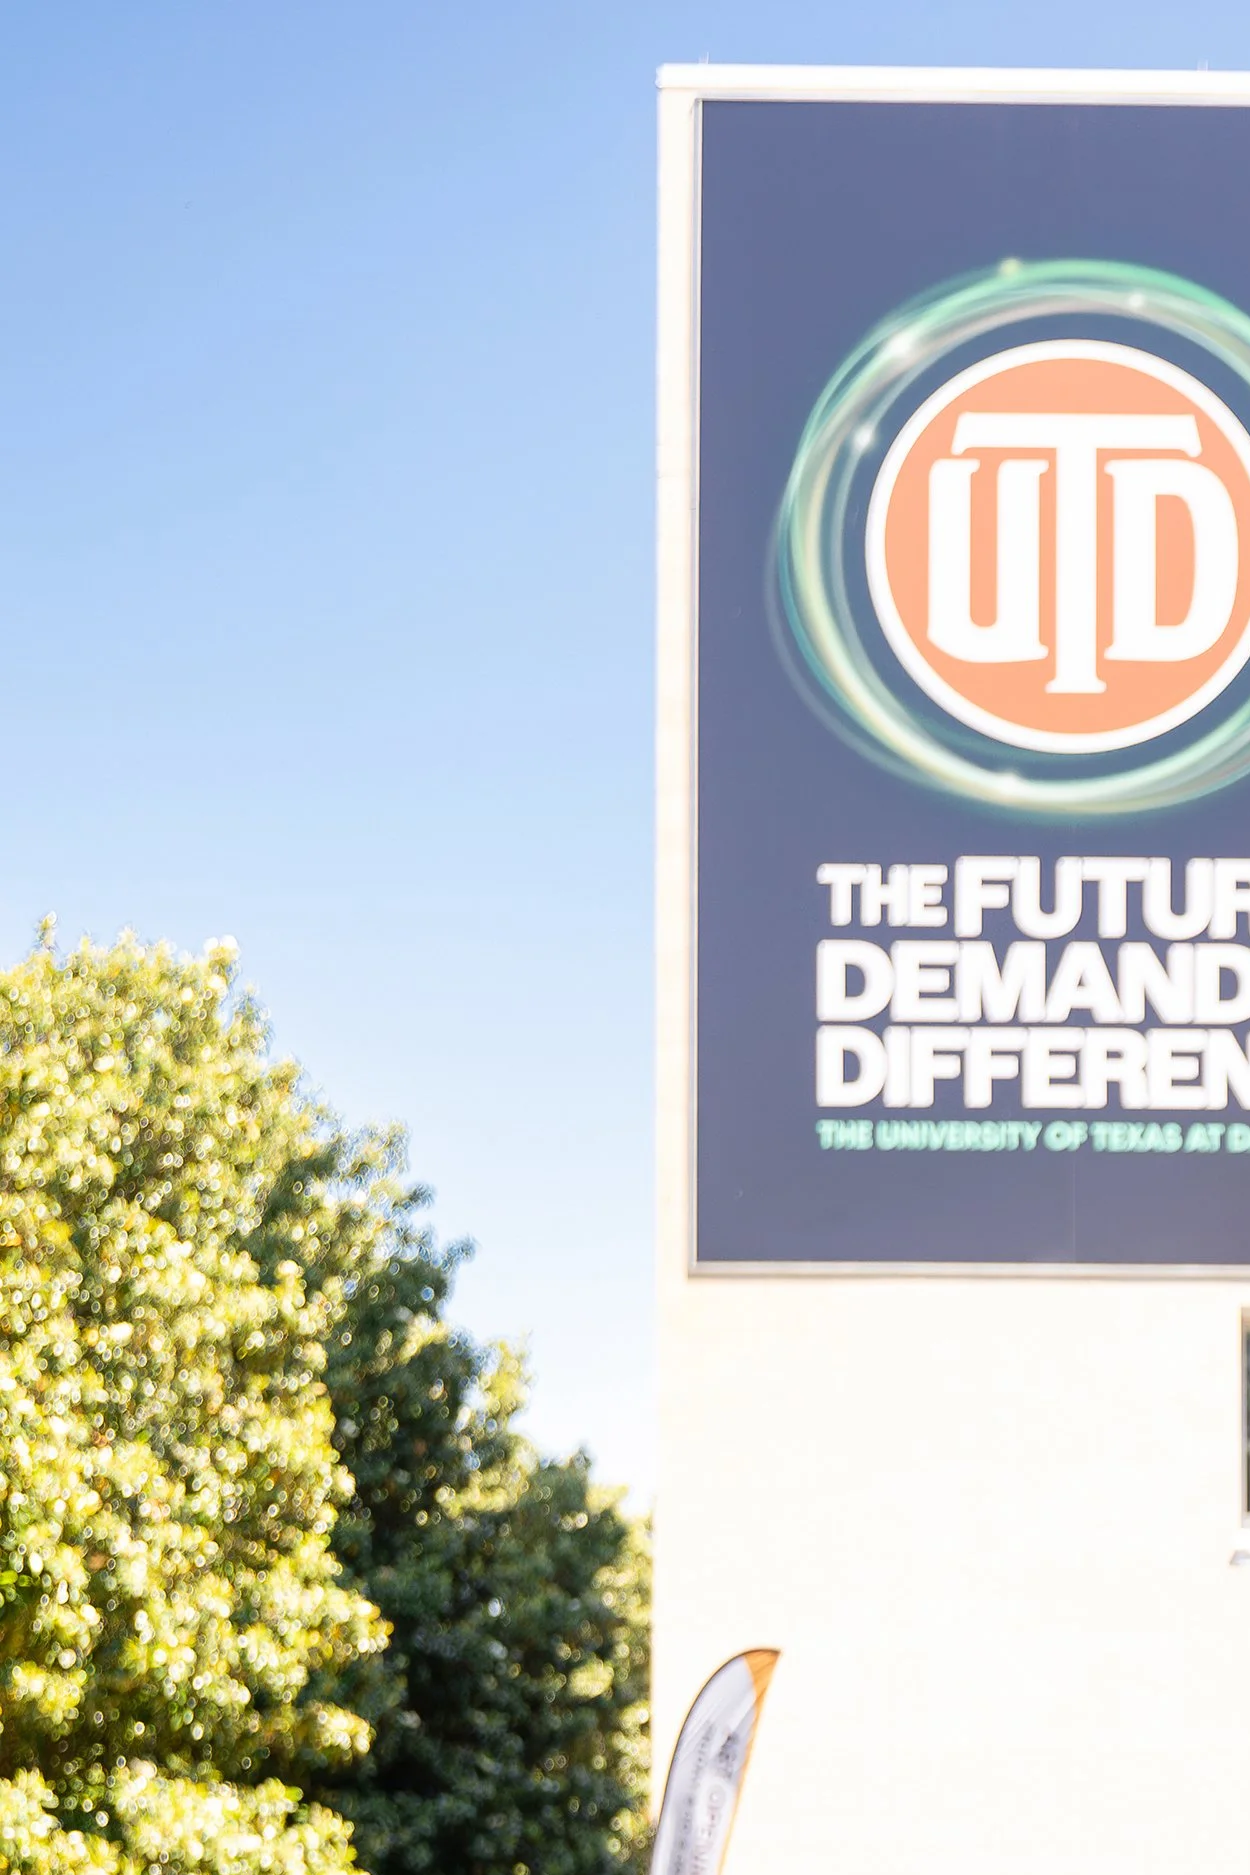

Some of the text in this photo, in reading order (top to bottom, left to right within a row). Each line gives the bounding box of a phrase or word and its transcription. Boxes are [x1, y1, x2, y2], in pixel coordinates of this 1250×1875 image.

[926, 411, 1239, 694] UTD
[816, 862, 948, 927] THE
[815, 1119, 873, 1150] THE
[875, 1120, 1043, 1151] UNIVERSITY
[1043, 1120, 1088, 1152] OF
[1089, 1121, 1183, 1153] TEXAS
[1183, 1121, 1226, 1153] AT
